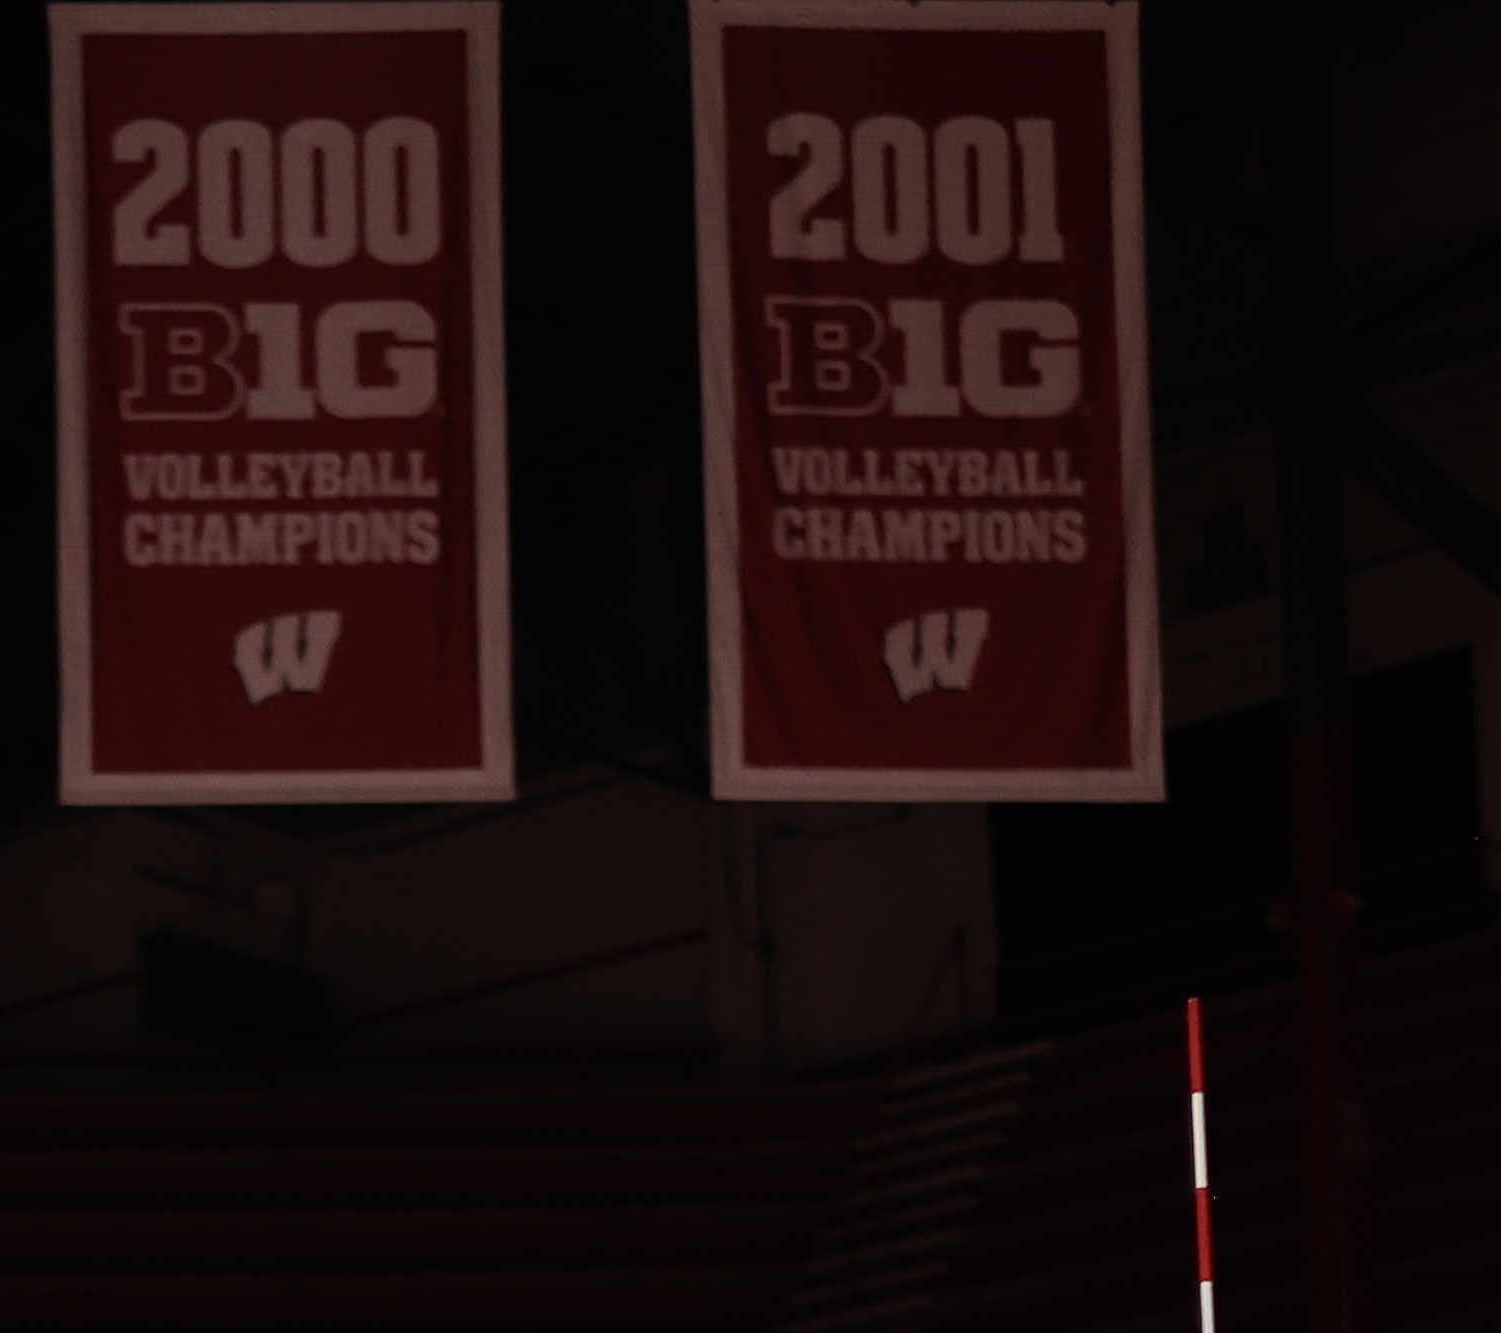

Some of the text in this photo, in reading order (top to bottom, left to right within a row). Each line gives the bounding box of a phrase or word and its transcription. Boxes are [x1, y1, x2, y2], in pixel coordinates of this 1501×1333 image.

[110, 117, 442, 268] 2000
[765, 112, 1065, 265] 2001
[123, 450, 439, 500] VOLLEYBALL
[772, 446, 1085, 498] VOLLEYBALL
[122, 510, 441, 566] CHAMPIONS
[771, 507, 1087, 564] CHAMPIONS
